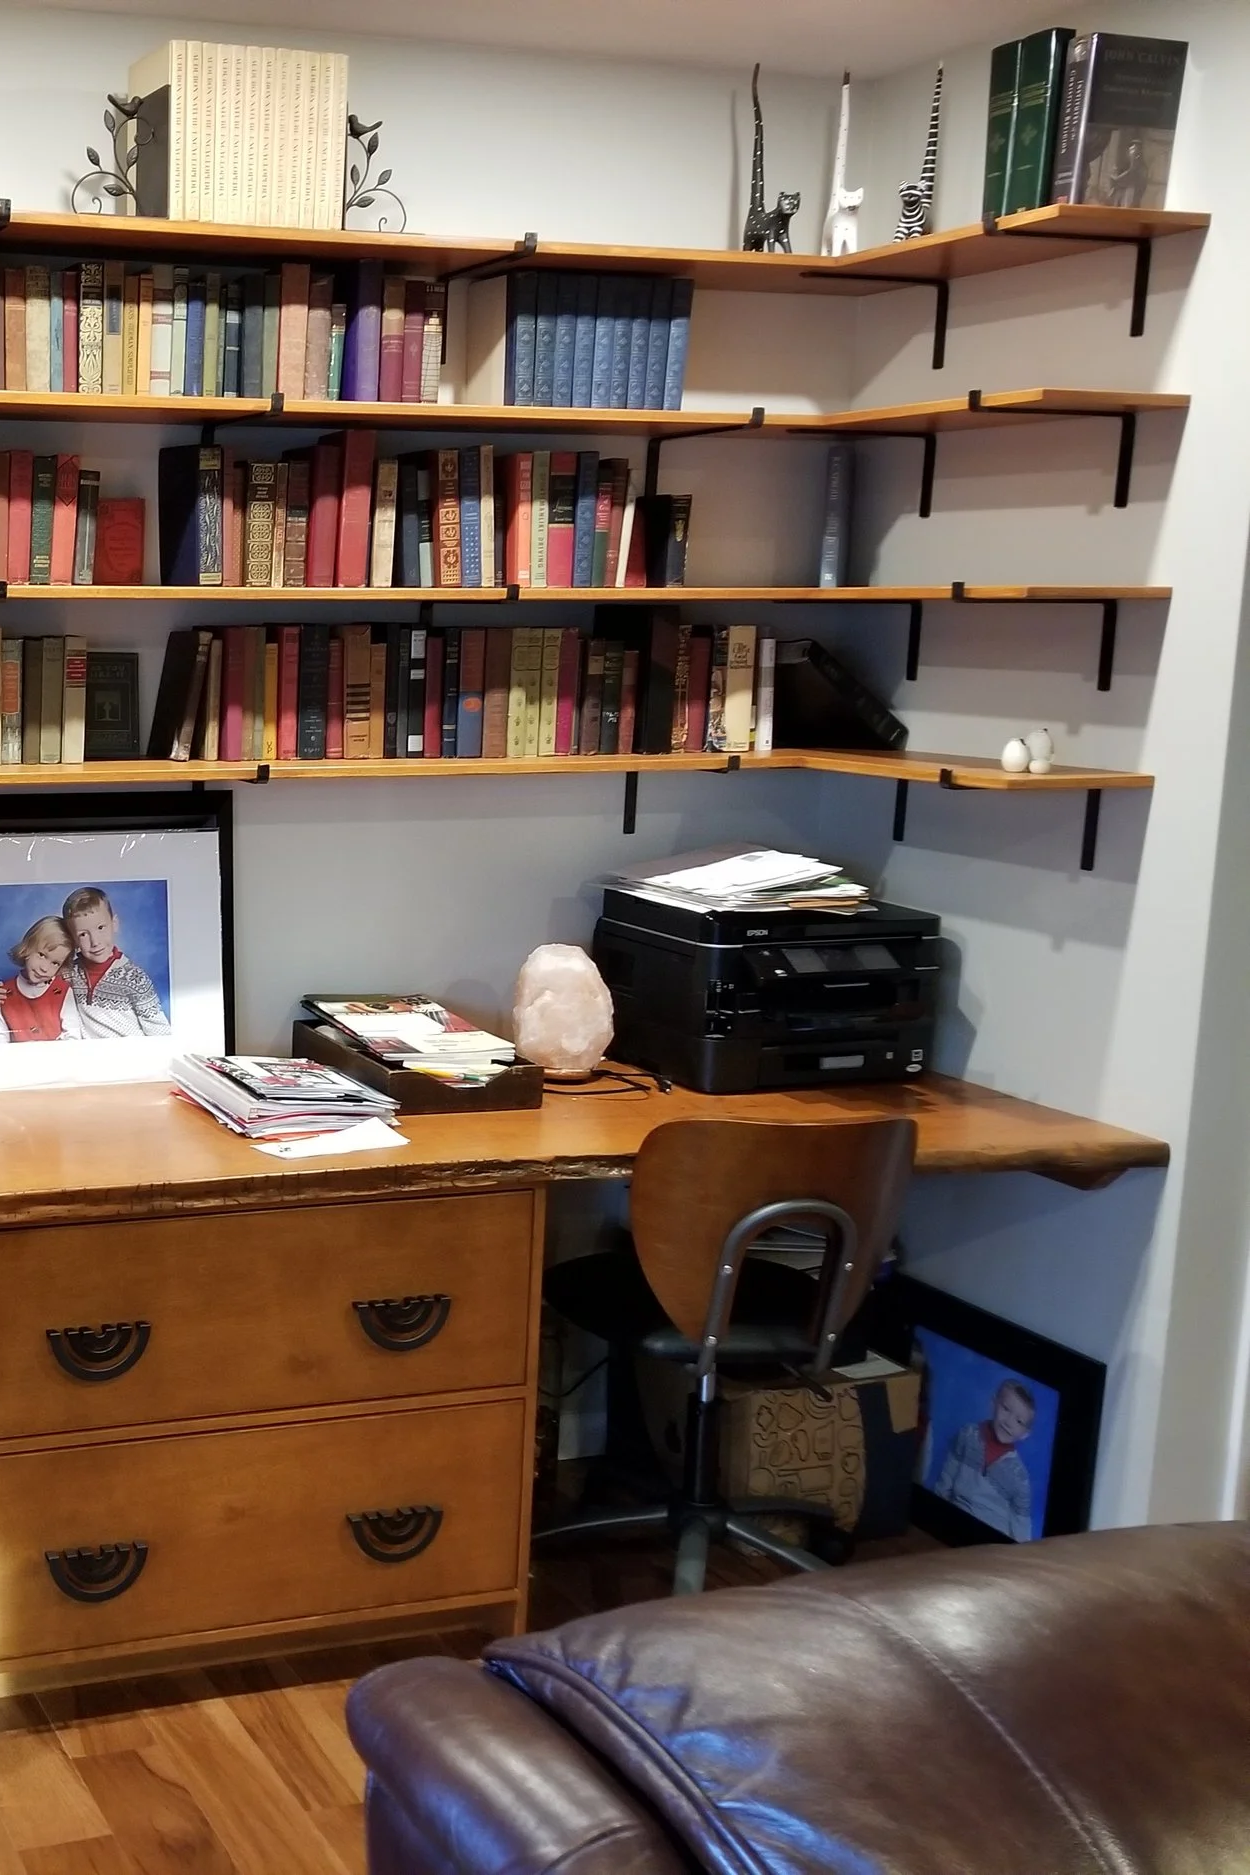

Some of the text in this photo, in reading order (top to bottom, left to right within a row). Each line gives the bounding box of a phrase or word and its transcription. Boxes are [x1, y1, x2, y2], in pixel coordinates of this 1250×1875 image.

[189, 131, 197, 195] ENCYCLOPEDIA
[203, 133, 212, 196] ENCYCLOPEDIA
[218, 134, 226, 197] ENCYCLOPEDIA
[232, 135, 240, 197] ENCYCLOPEDIA
[246, 136, 254, 198] ENCYCLOPEDIA
[260, 136, 269, 199] ENCYCLOPEDIA
[290, 139, 298, 201] ENCYCLOPEDIA
[304, 140, 313, 202] ENCYCLOPEDIA
[318, 141, 328, 204] ENCYCLOPEDIA
[537, 537, 545, 569] DRIVING
[746, 929, 769, 937] EPSON
